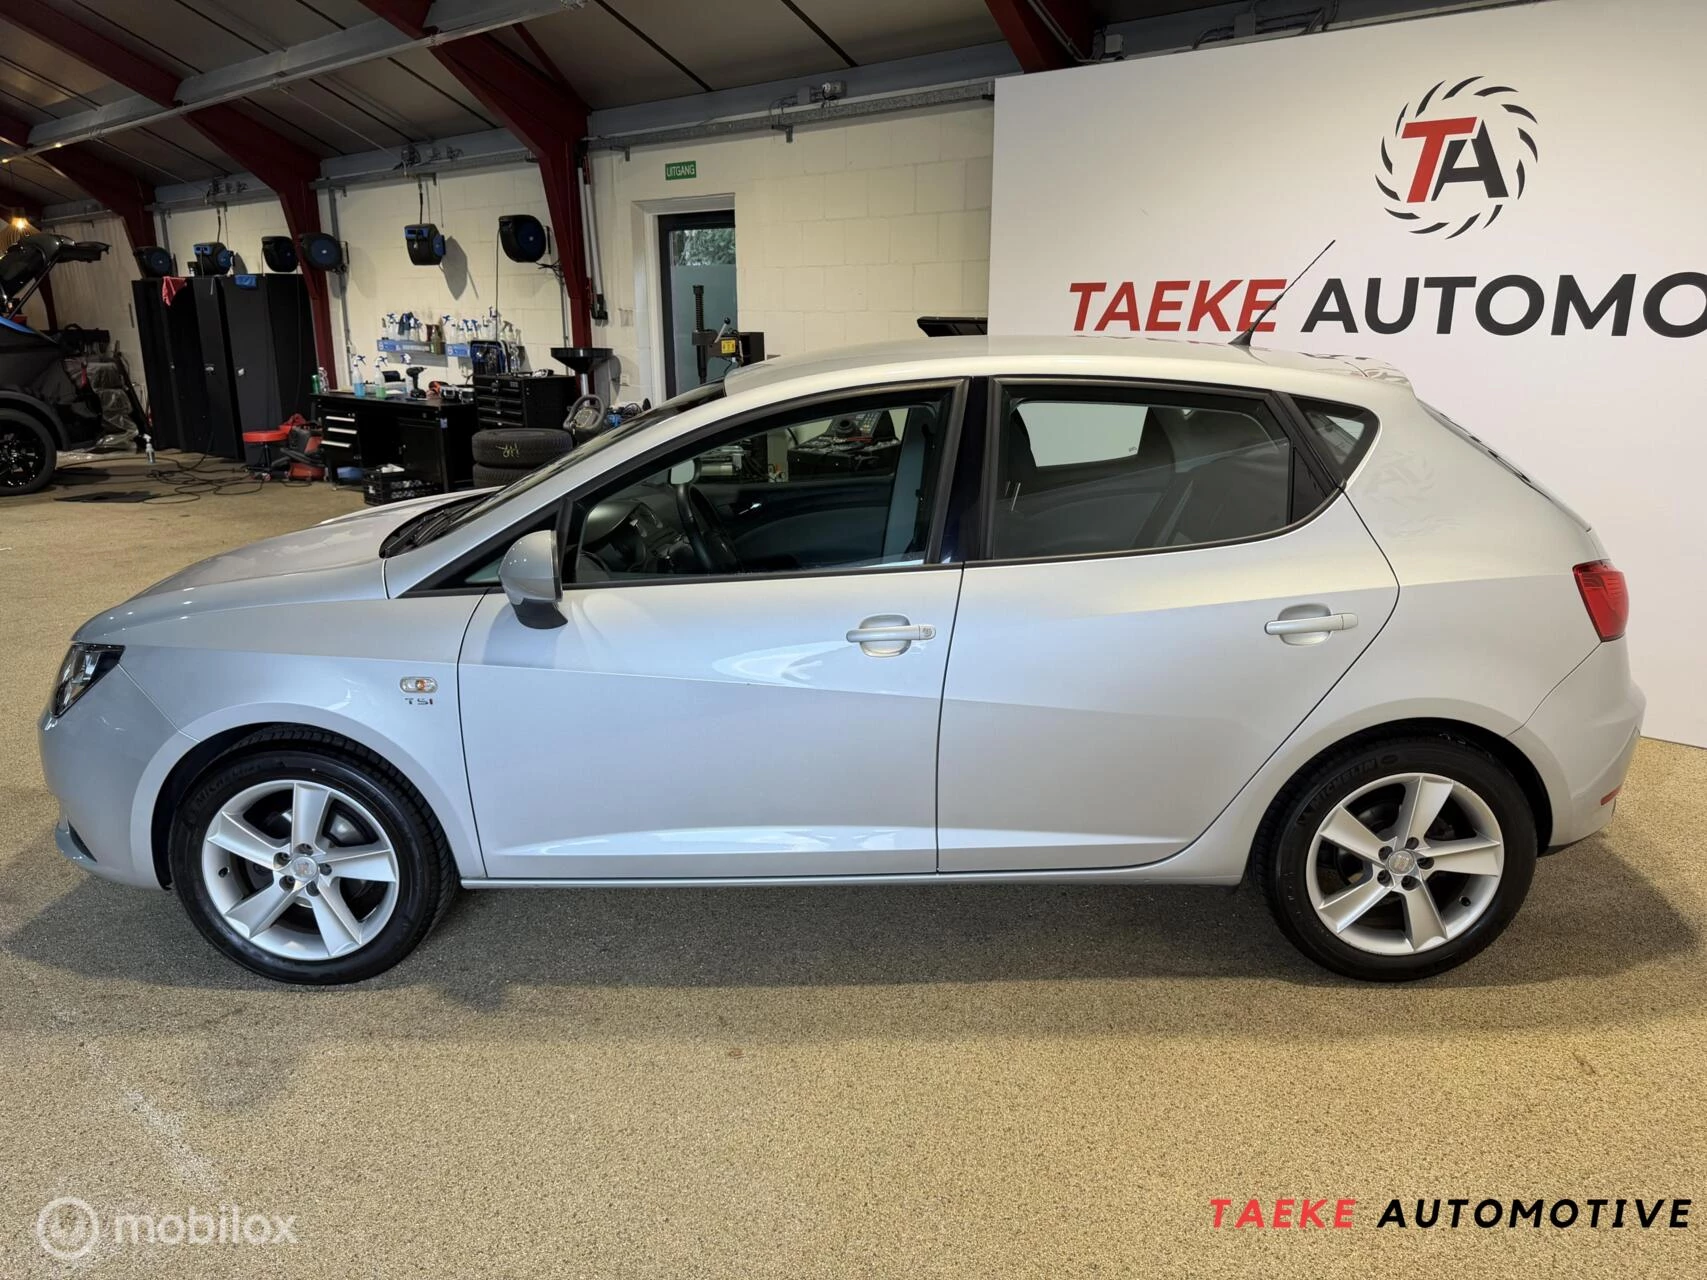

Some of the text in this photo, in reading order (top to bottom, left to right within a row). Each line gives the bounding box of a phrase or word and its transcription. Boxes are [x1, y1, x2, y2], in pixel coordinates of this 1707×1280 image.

[666, 164, 696, 177] UITGANG
[1402, 115, 1509, 204] TA
[1070, 272, 1707, 338] TAEKE AUTOMO
